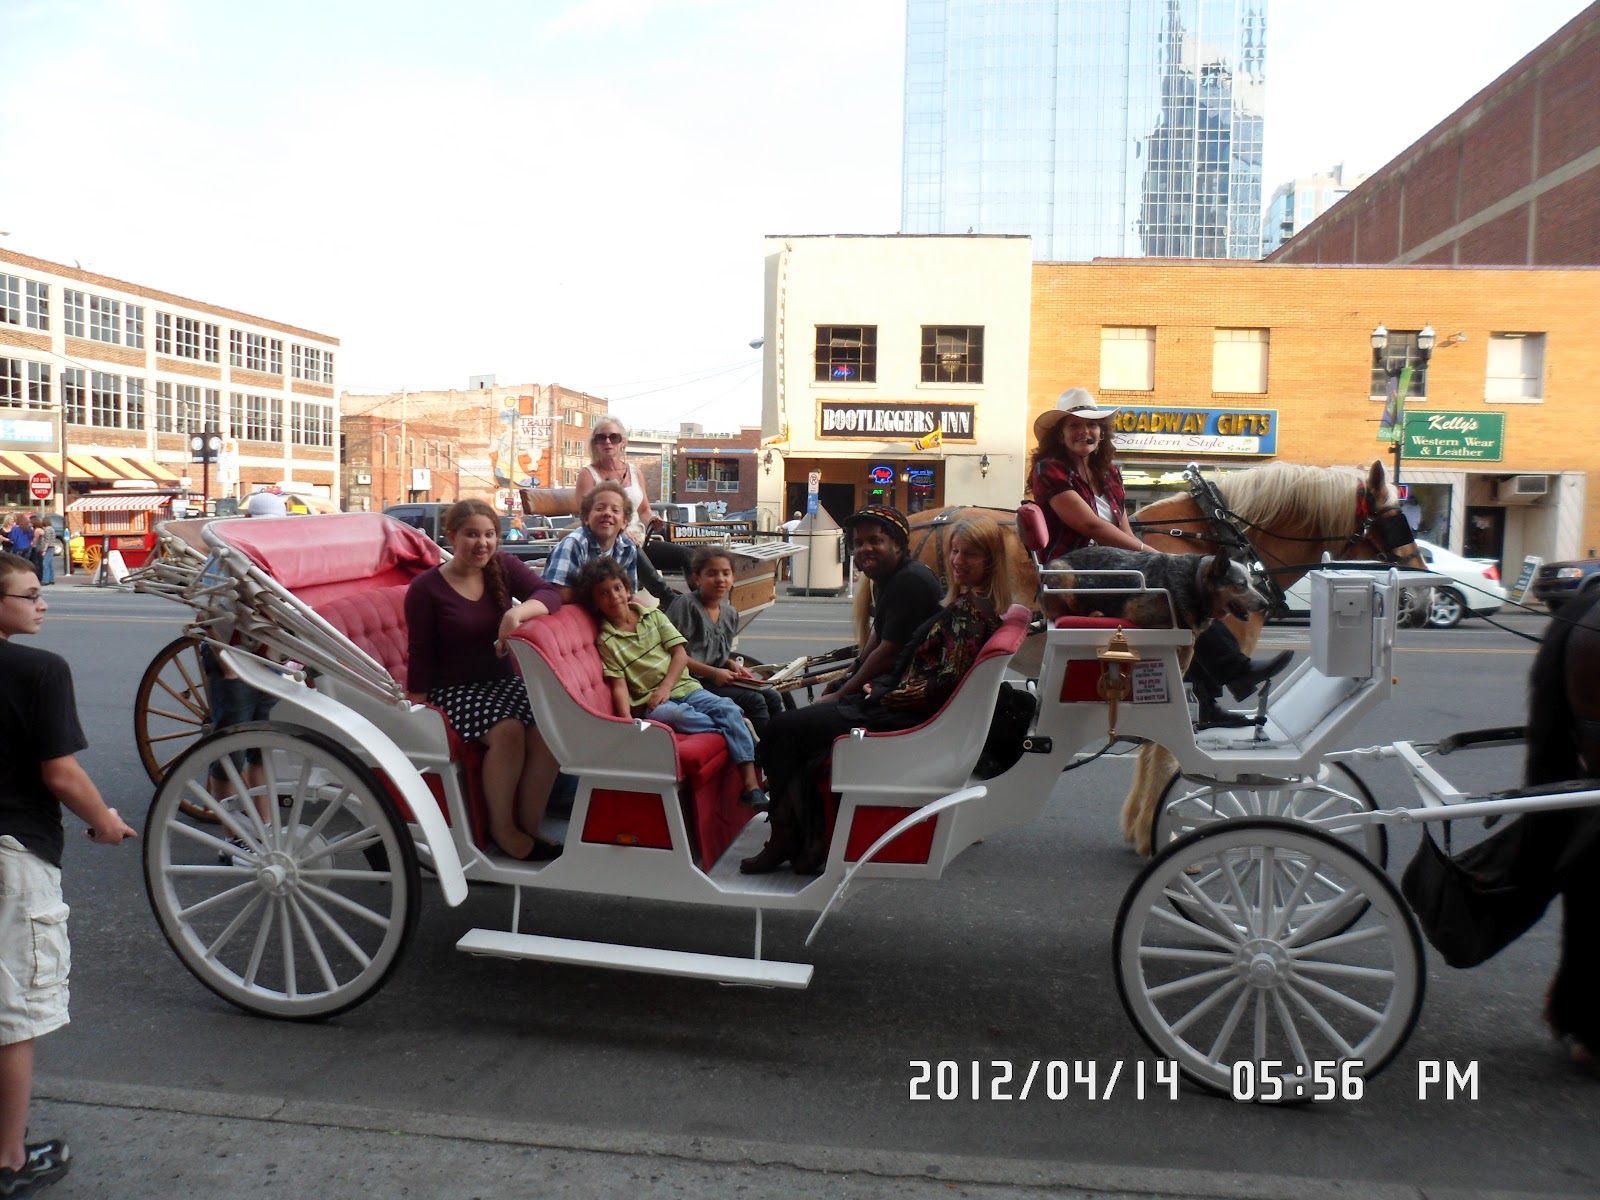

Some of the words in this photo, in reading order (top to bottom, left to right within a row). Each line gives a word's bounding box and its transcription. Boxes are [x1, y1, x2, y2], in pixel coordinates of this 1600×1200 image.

[521, 417, 551, 426] TRAIL
[823, 409, 934, 433] BOOTLEGGERS
[941, 411, 970, 433] INN
[1111, 411, 1209, 433] ROADWAY
[1217, 413, 1271, 435] GIFTS
[1428, 415, 1479, 433] Kelly's
[521, 426, 550, 436] WEST
[1113, 434, 1181, 447] Southern
[1186, 436, 1225, 449] Style
[1411, 436, 1459, 446] Western
[1464, 437, 1495, 447] Wear
[1420, 446, 1431, 455] &
[1436, 446, 1484, 457] Leather
